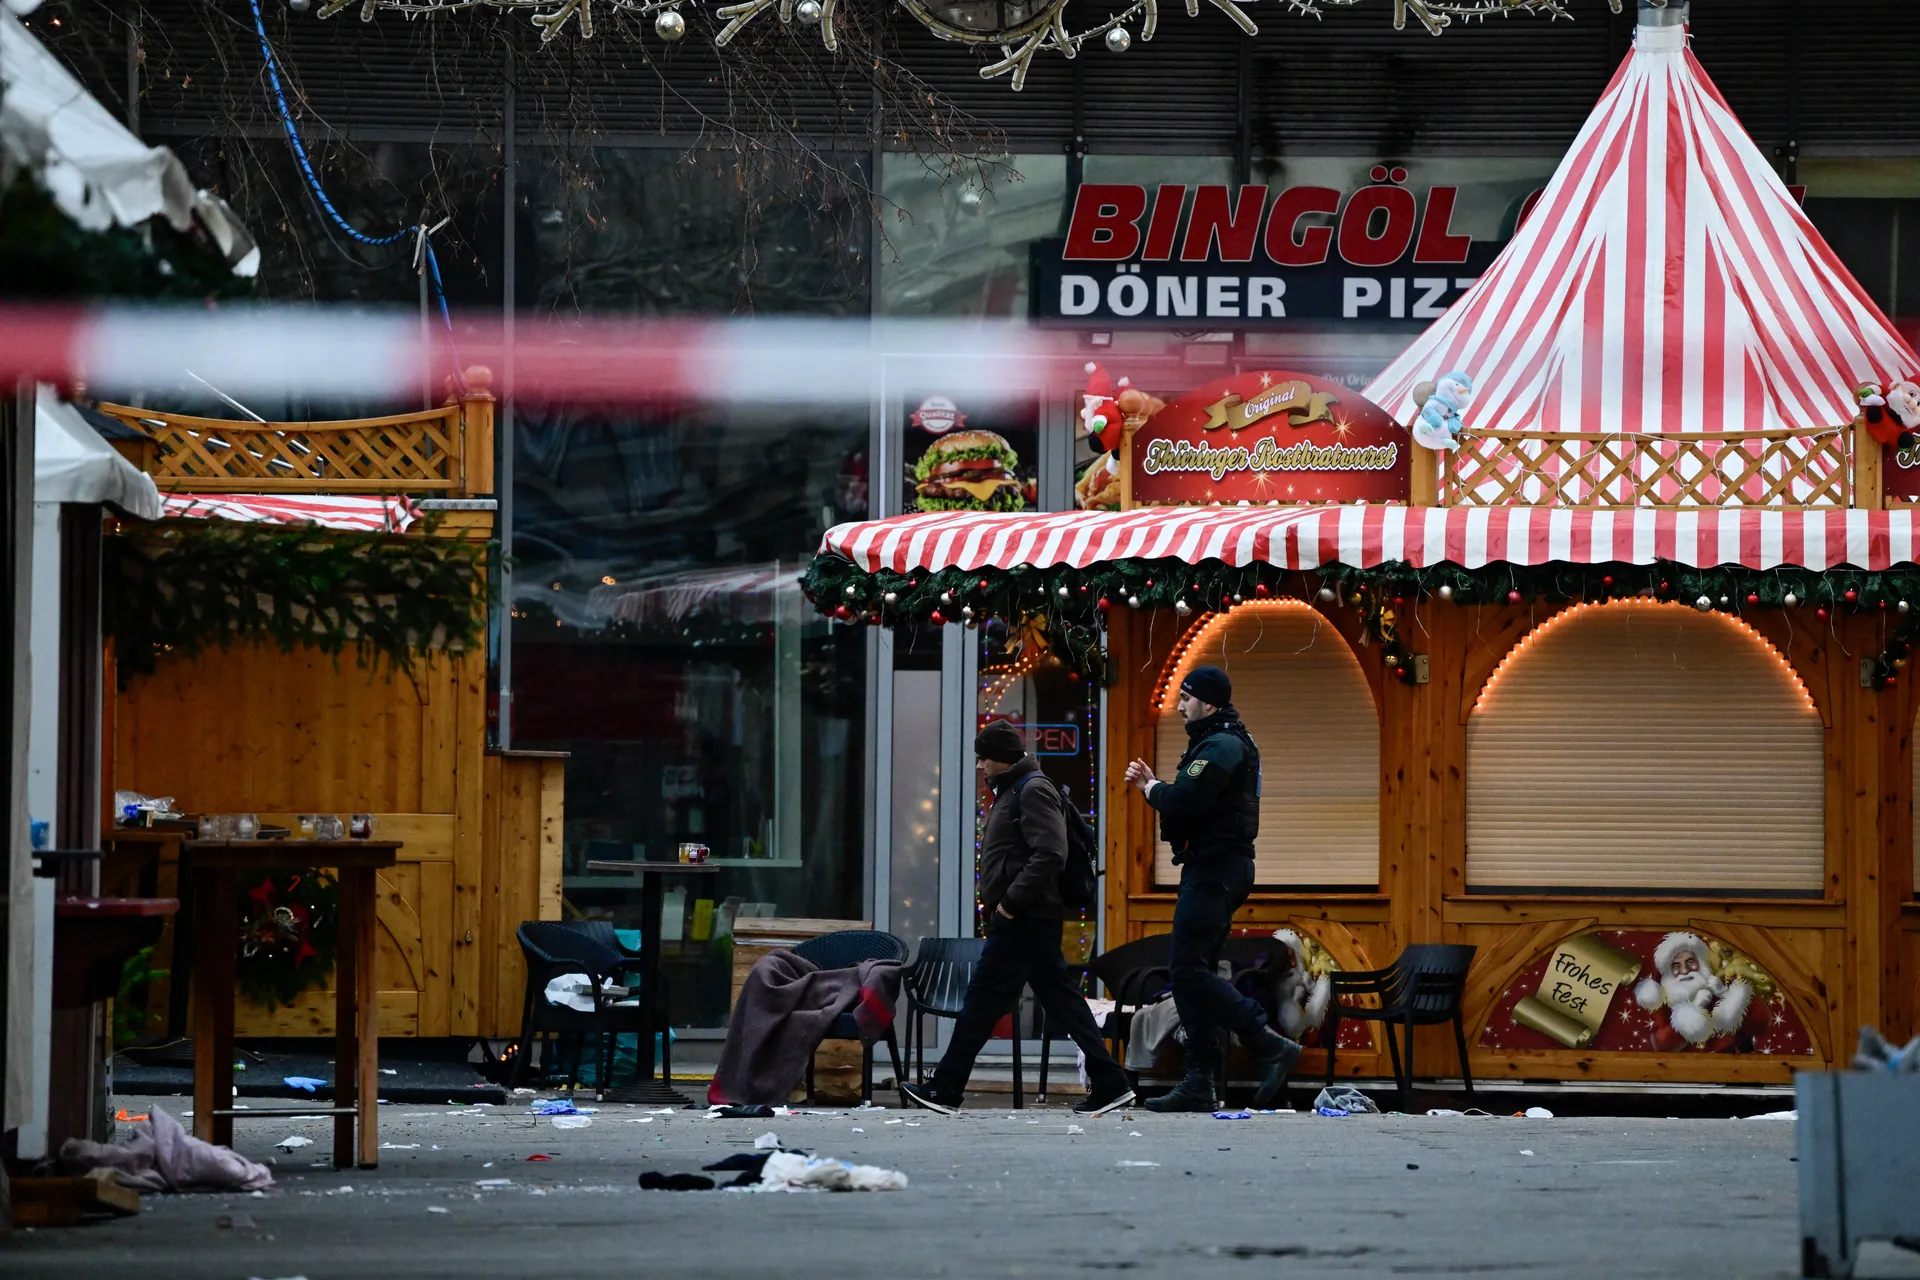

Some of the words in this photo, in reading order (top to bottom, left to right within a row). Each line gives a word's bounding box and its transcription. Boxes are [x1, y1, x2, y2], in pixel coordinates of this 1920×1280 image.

[1062, 165, 1472, 267] BINGÖL
[1060, 264, 1287, 318] DÖNER
[1343, 277, 1479, 318] PIZ
[1244, 387, 1296, 419] Original
[1144, 438, 1249, 481] Thüringer
[1249, 436, 1398, 470] Rostbratwurst
[1555, 952, 1613, 995] Frohes
[1552, 981, 1588, 1014] Fest
